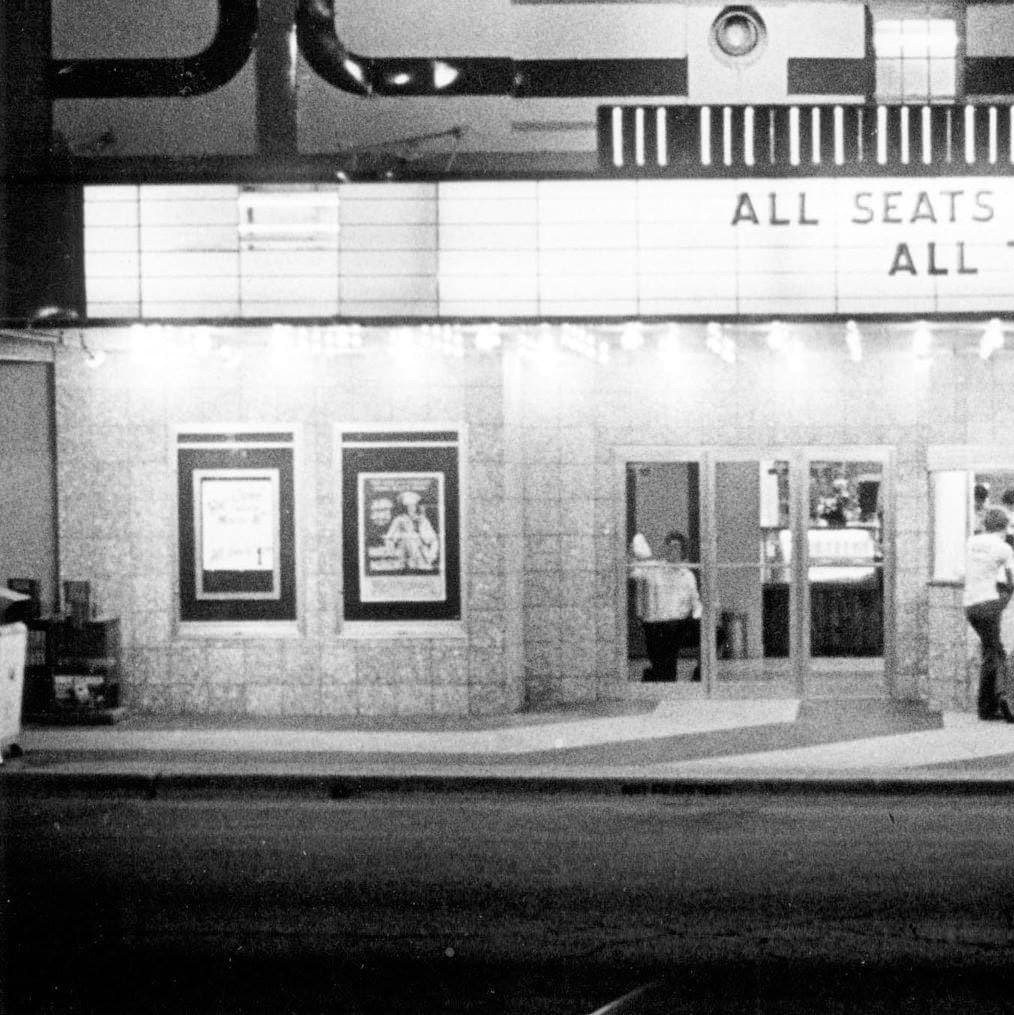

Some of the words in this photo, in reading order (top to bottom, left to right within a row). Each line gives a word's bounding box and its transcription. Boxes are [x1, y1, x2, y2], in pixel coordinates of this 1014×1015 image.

[731, 191, 819, 226] ALL
[852, 190, 994, 224] SEATS
[889, 241, 978, 275] ALL
